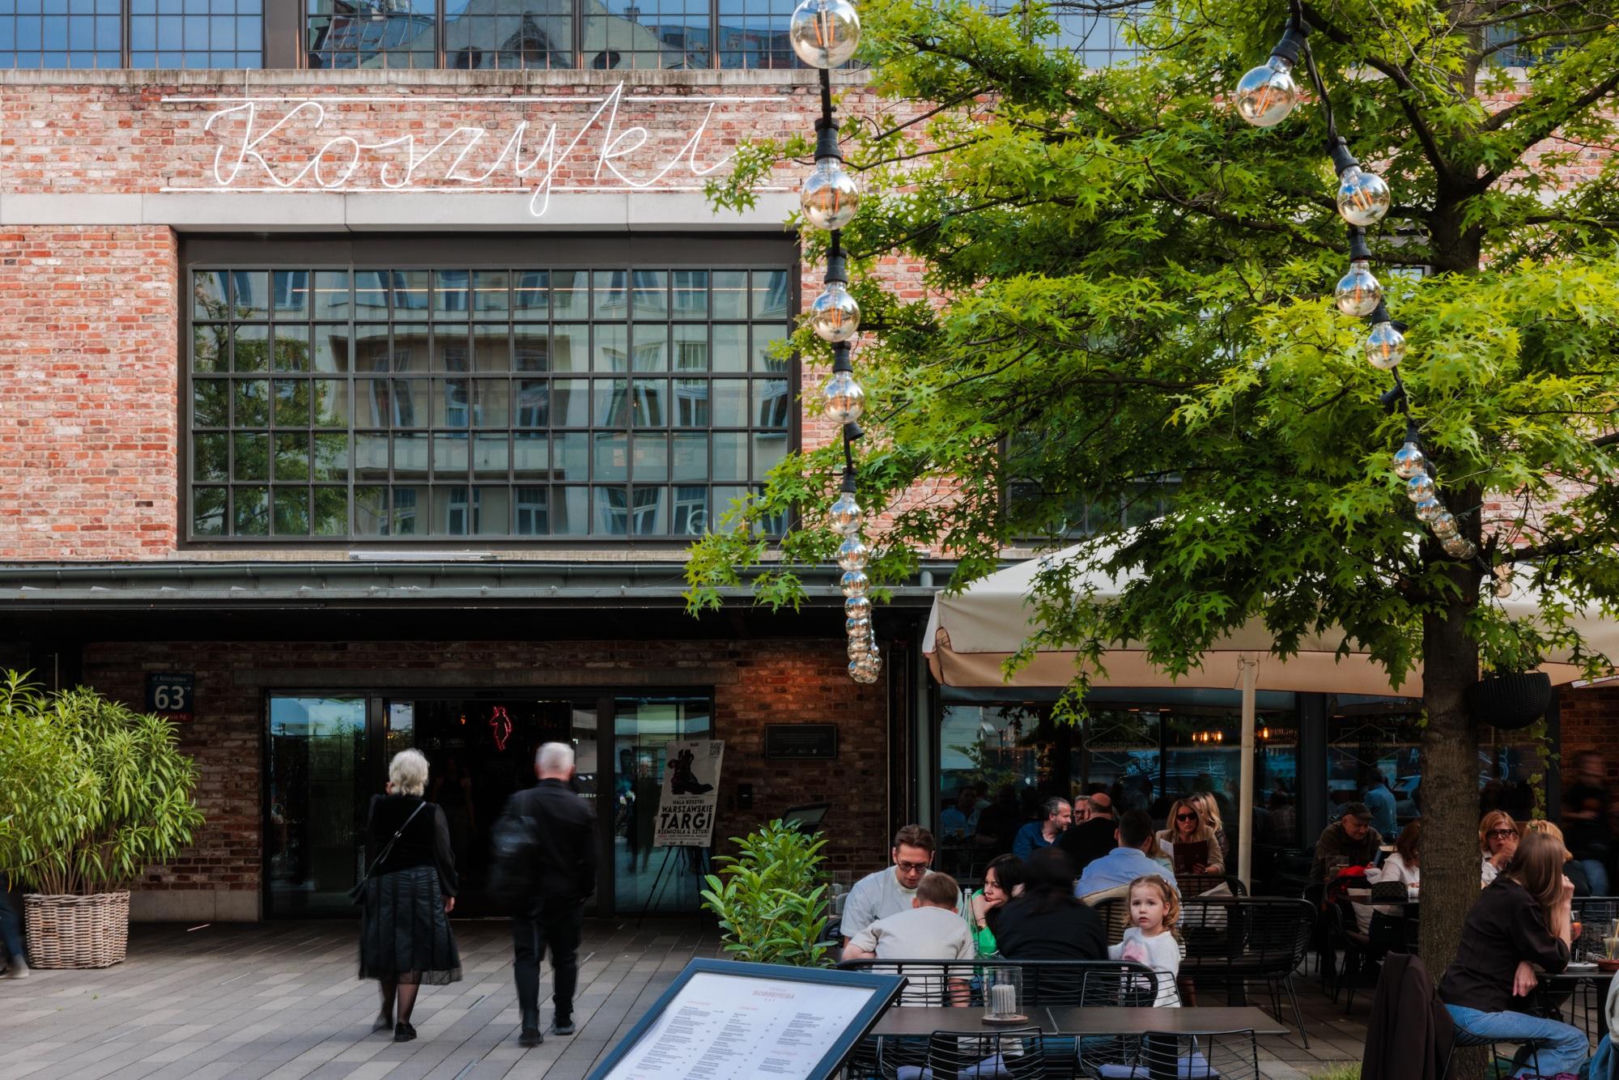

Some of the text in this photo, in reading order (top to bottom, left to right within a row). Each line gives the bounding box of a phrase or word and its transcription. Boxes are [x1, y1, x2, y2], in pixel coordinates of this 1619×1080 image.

[204, 80, 746, 217] Koszyki
[155, 685, 184, 710] 63
[662, 805, 713, 813] WARSZAWSKIE
[660, 813, 712, 829] TARGI
